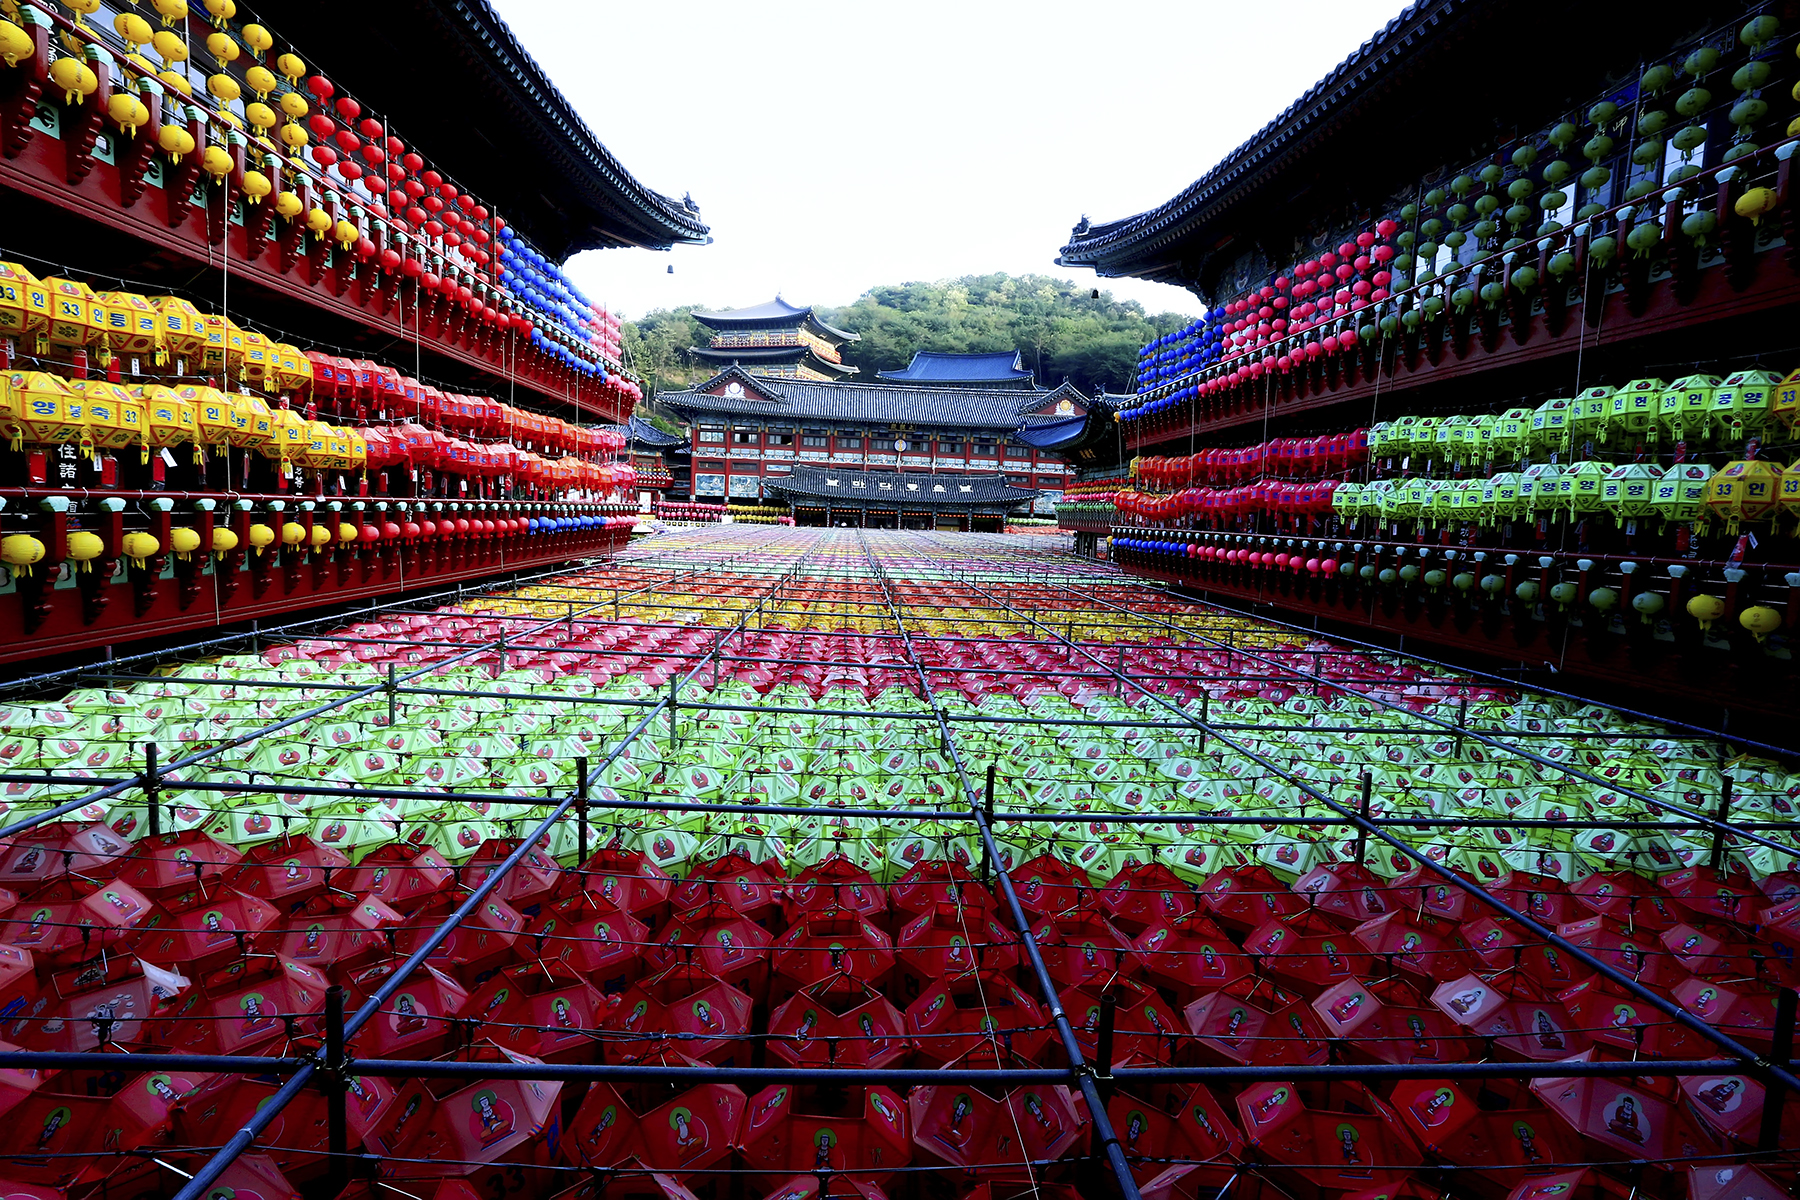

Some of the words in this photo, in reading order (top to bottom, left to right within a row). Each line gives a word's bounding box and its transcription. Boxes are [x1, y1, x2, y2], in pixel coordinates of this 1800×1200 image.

[31, 292, 45, 308] 인
[61, 301, 81, 316] 33
[93, 308, 104, 324] 인
[109, 312, 127, 328] 등
[139, 317, 154, 330] 공
[167, 315, 182, 330] 등
[1664, 396, 1677, 408] 33
[1688, 393, 1703, 406] 인
[1718, 393, 1733, 406] 공
[1744, 392, 1764, 404] 양
[1781, 390, 1796, 404] 33
[32, 400, 57, 416] 양
[69, 404, 82, 418] 봉
[1590, 403, 1603, 413] 33
[1614, 398, 1623, 410] 인
[90, 406, 111, 420] 축
[125, 410, 137, 423] 33
[155, 407, 173, 421] 축
[206, 407, 220, 421] 인
[1551, 415, 1563, 425] 봉
[258, 420, 269, 431] 봉
[1506, 424, 1517, 433] 33
[287, 428, 299, 440] 인
[1402, 428, 1411, 436] 33
[1466, 430, 1474, 439] 33
[1522, 483, 1533, 493] 공
[1542, 482, 1557, 492] 양
[1561, 481, 1571, 491] 공
[1579, 480, 1596, 490] 양
[1606, 485, 1618, 496] 공
[1627, 485, 1645, 496] 양
[1716, 483, 1732, 496] 33
[1748, 482, 1766, 496] 인
[1784, 480, 1799, 493] 33
[1484, 489, 1493, 499] 공
[1501, 489, 1514, 498] 양
[1659, 487, 1675, 498] 양
[1685, 487, 1702, 499] 봉
